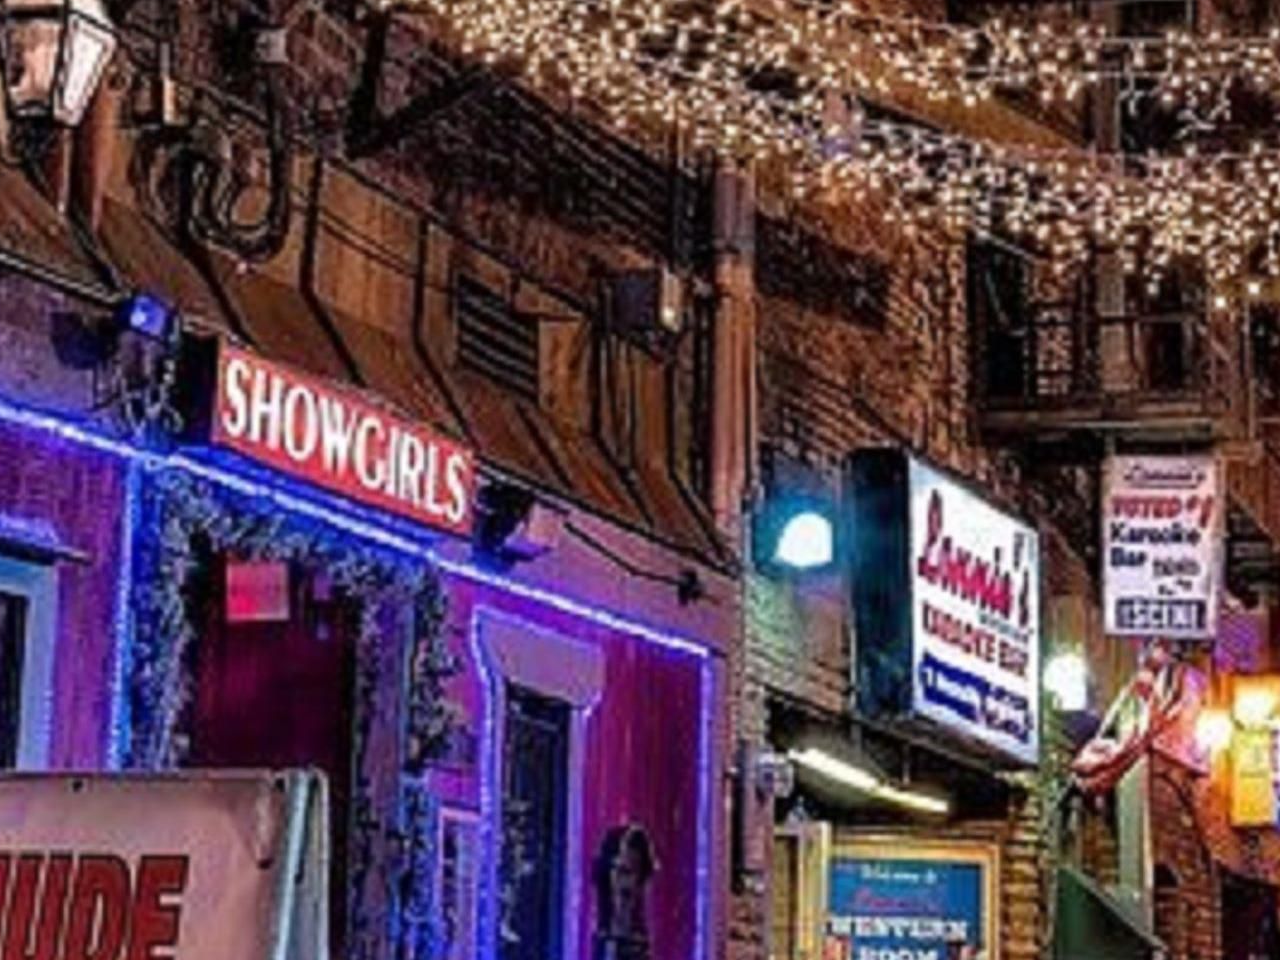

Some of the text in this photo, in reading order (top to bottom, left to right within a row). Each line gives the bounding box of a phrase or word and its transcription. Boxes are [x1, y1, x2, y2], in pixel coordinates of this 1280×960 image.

[222, 358, 469, 526] SHOWGIRLS
[1111, 494, 1183, 519] VOTED
[1110, 522, 1202, 545] Karaoke
